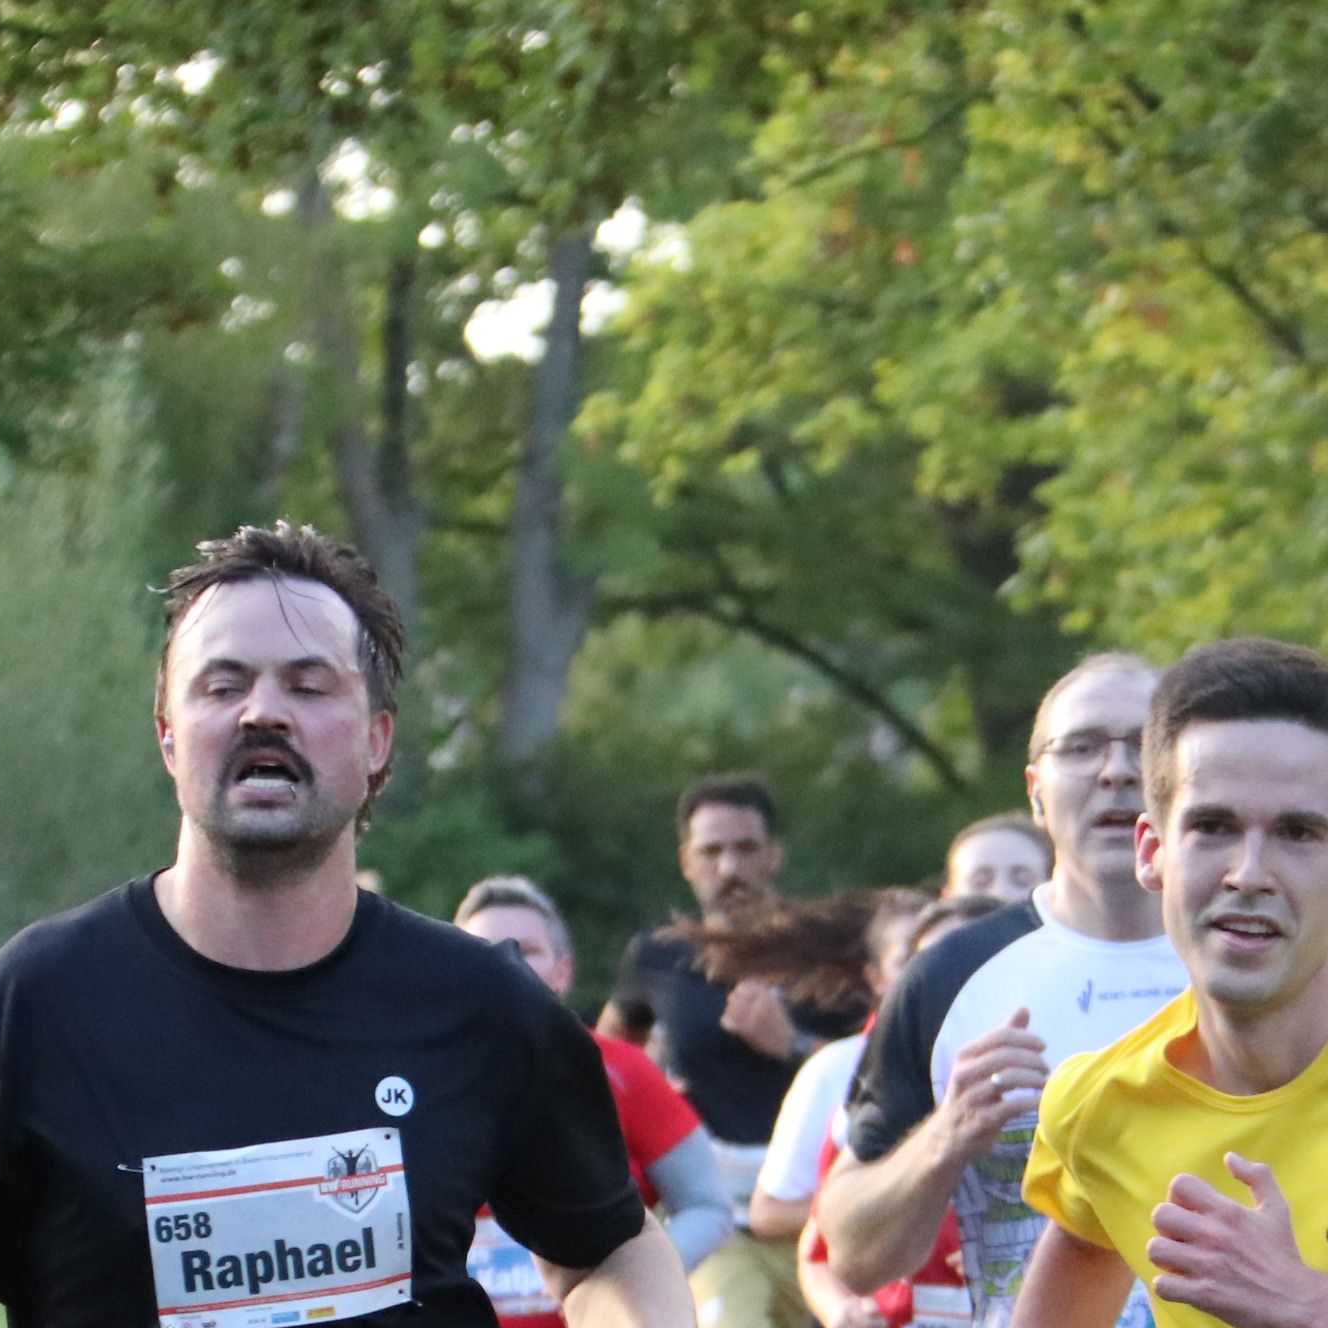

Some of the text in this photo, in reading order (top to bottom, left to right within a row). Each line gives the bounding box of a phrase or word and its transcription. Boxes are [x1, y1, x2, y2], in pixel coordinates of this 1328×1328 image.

[381, 1087, 408, 1105] JK
[154, 1211, 213, 1243] 658
[180, 1226, 377, 1295] Raphael
